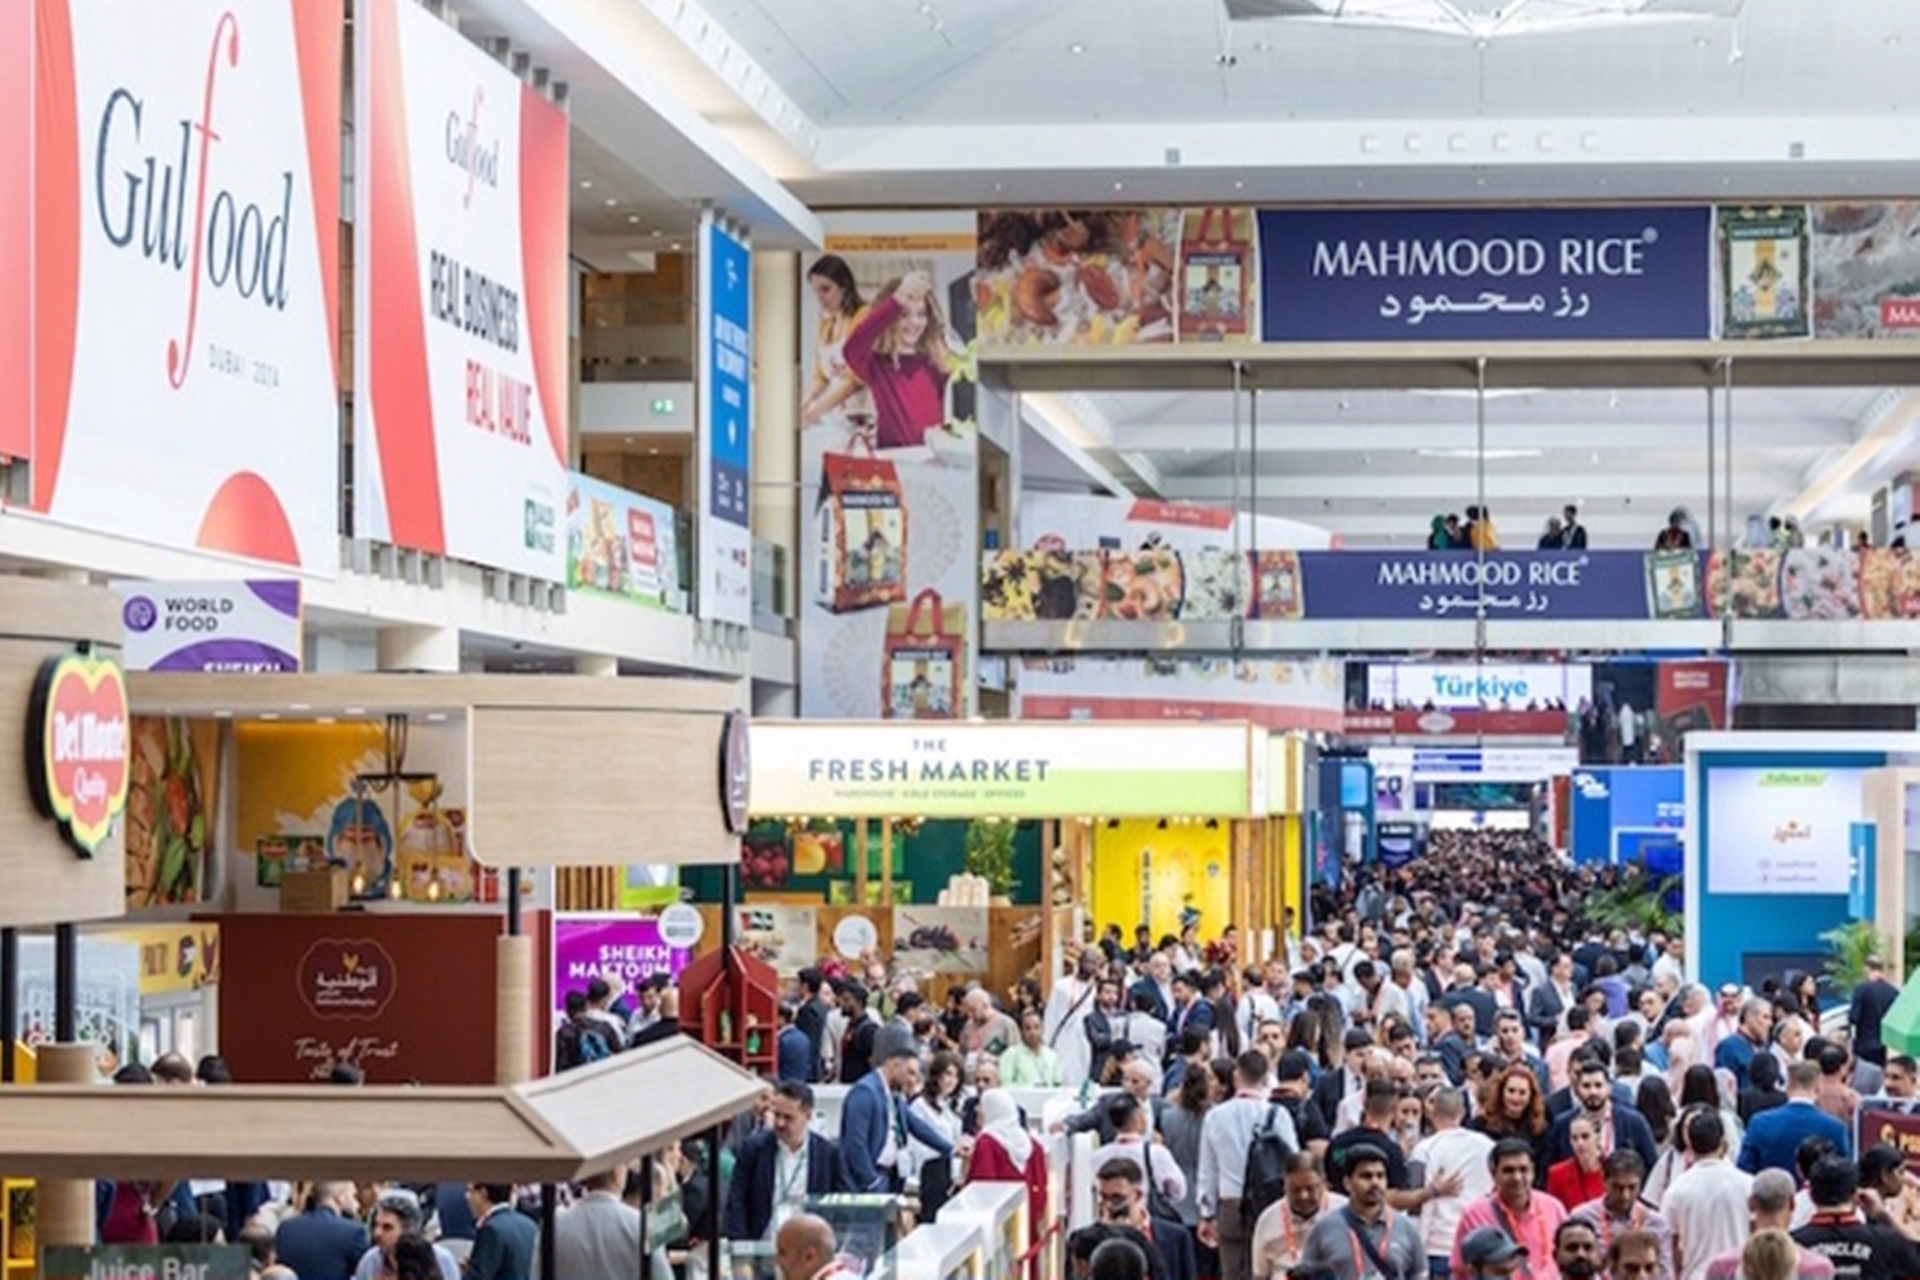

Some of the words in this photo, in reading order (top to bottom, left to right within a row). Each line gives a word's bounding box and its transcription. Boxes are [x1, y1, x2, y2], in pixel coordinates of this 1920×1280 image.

[445, 84, 499, 210] Gulfood
[95, 10, 294, 390] Gulfood
[1313, 238, 1545, 277] MAHMOOD
[1560, 238, 1645, 276] RICE
[430, 249, 462, 329] REAL
[463, 264, 519, 354] BUSINESS
[1553, 286, 1591, 317] رز
[466, 358, 495, 434] REAL
[498, 367, 532, 446] VALUE
[1378, 561, 1522, 585] MAHMOOD
[1529, 561, 1582, 585] RICE
[165, 598, 234, 614] WORLD
[1525, 590, 1549, 611] رز
[165, 616, 218, 632] FOOD
[1433, 673, 1528, 702] Türkiye
[54, 711, 80, 761] Del
[913, 738, 948, 751] THE
[808, 759, 909, 782] FRESH
[919, 759, 1051, 782] MARKET
[599, 944, 671, 961] SHEIKH
[92, 1257, 154, 1280] Juice
[162, 1258, 209, 1280] Bar
